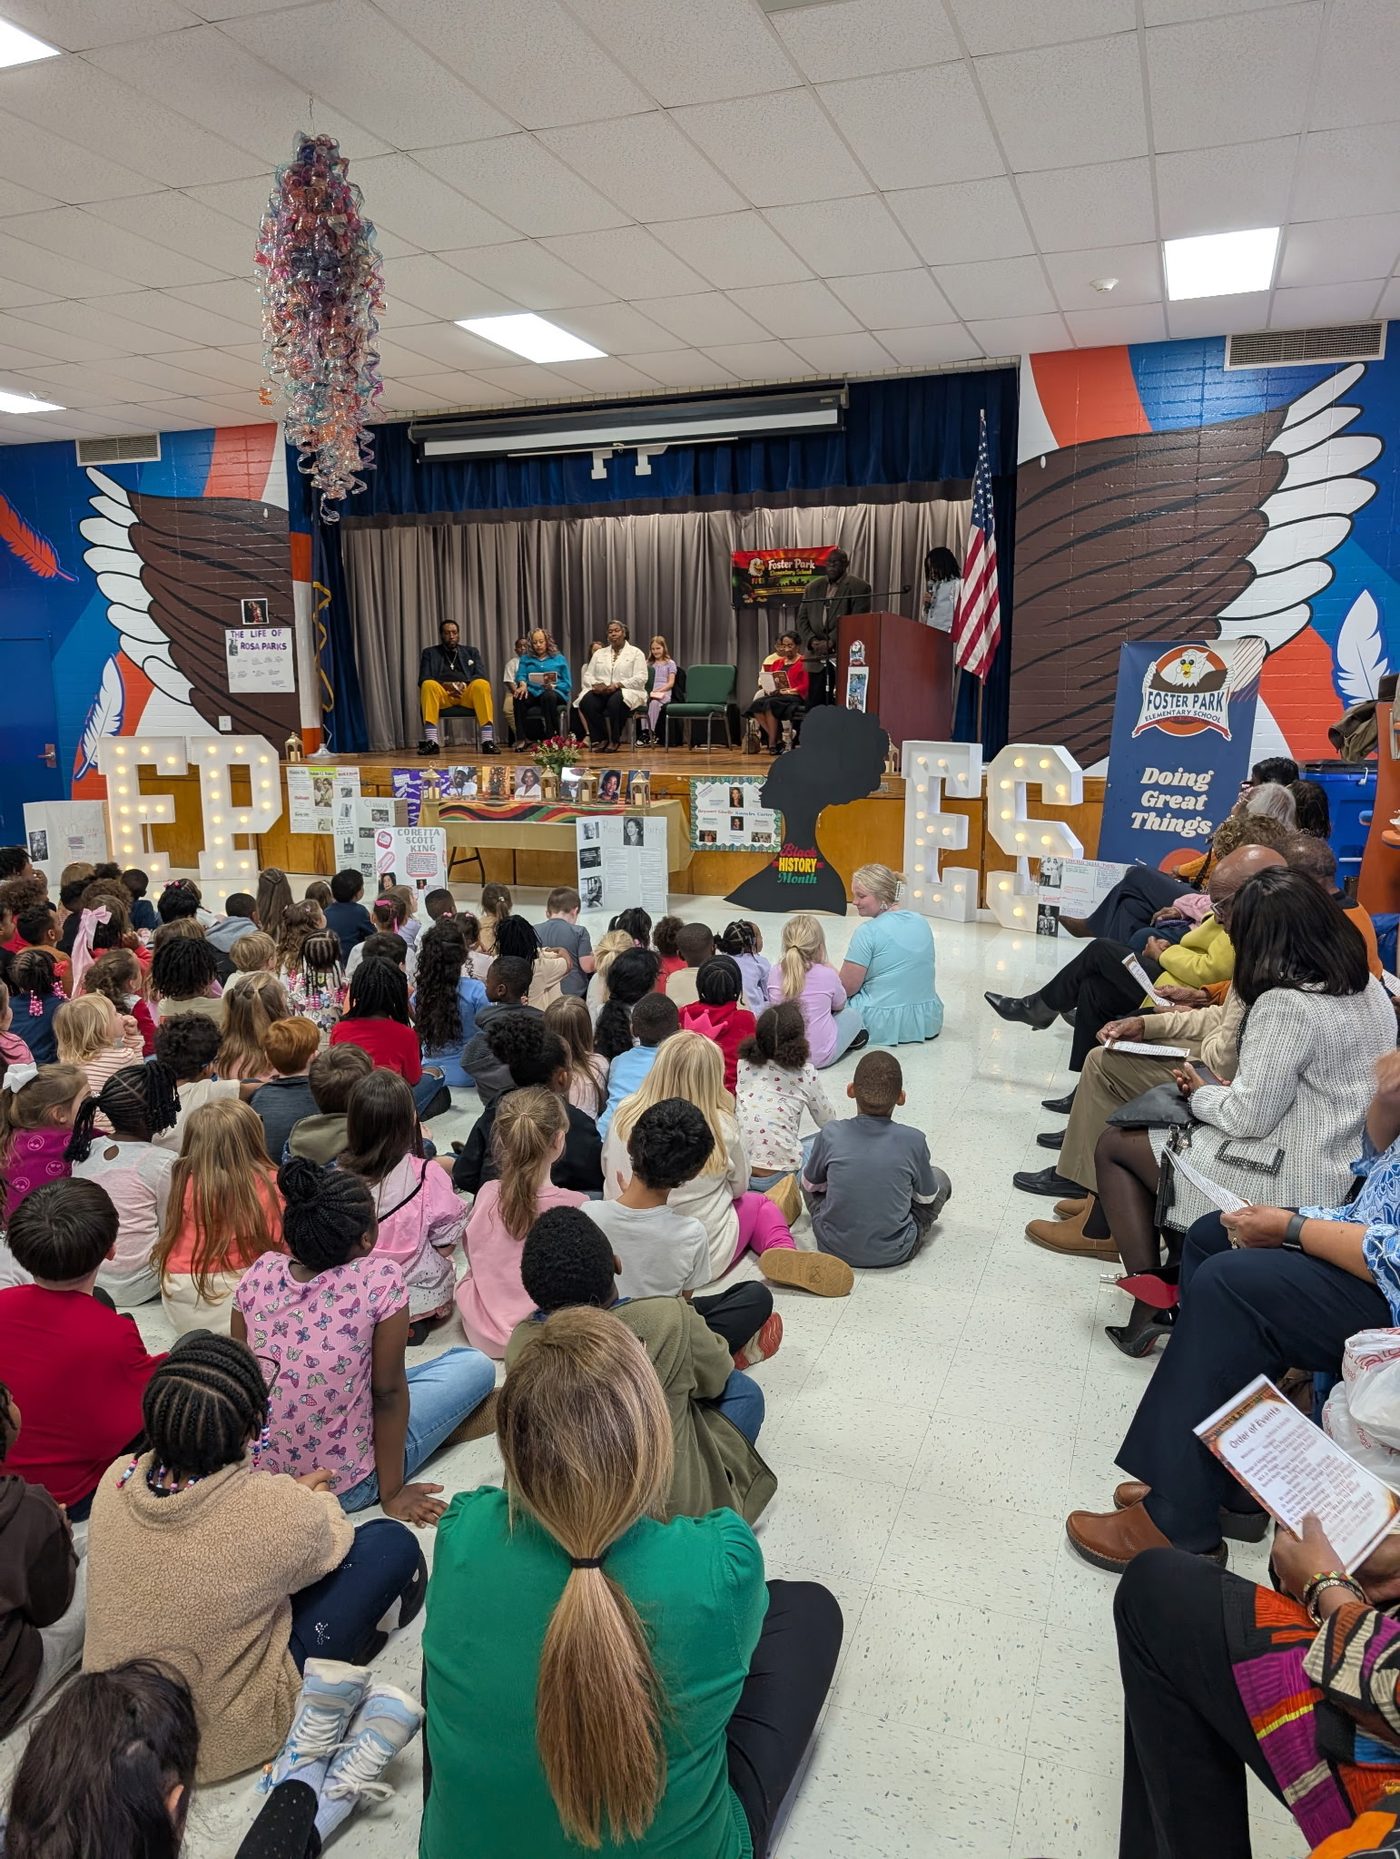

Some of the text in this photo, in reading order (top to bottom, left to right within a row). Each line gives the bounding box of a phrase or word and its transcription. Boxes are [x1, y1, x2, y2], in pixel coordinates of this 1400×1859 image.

[768, 558, 816, 570] Foster Park
[230, 629, 282, 639] THE LIFE OF
[240, 642, 287, 651] ROSA PARKS
[1146, 691, 1225, 712] FOSTER PARK
[1144, 709, 1221, 723] ELEMENTARY SCHOOL
[1140, 767, 1215, 792] Doing
[1141, 790, 1208, 811] Great
[1131, 811, 1213, 838] Things
[780, 843, 817, 857] Black
[779, 857, 817, 873] HISTORY
[777, 872, 817, 884] Month
[1230, 1431, 1250, 1449] Order
[1248, 1422, 1258, 1434] of
[1255, 1407, 1281, 1428] Events
